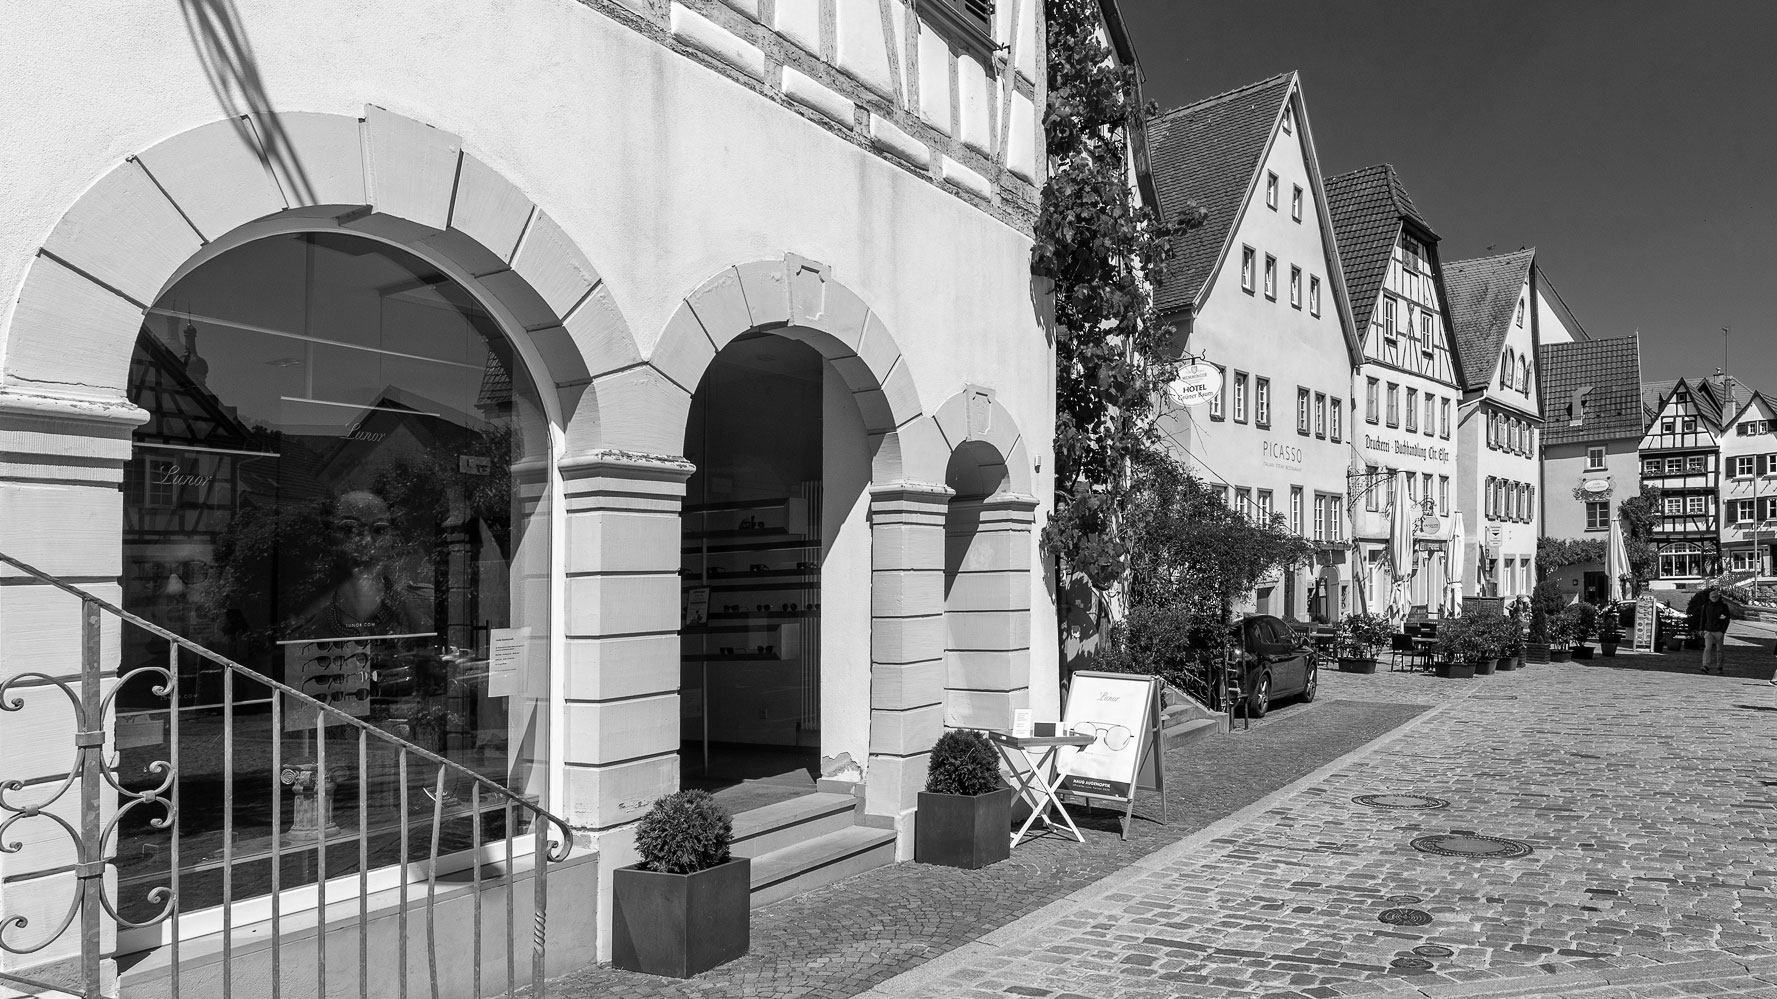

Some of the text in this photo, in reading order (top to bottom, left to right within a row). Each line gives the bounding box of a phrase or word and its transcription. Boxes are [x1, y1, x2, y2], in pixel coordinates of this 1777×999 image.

[1183, 384, 1207, 393] HOTEL
[339, 423, 386, 442] Lunor
[1263, 440, 1302, 463] PICASSO
[1365, 434, 1390, 453] Druckerei
[1395, 439, 1426, 461] Buchhandlung
[151, 465, 212, 486] Lunor
[1096, 691, 1120, 702] Lunor
